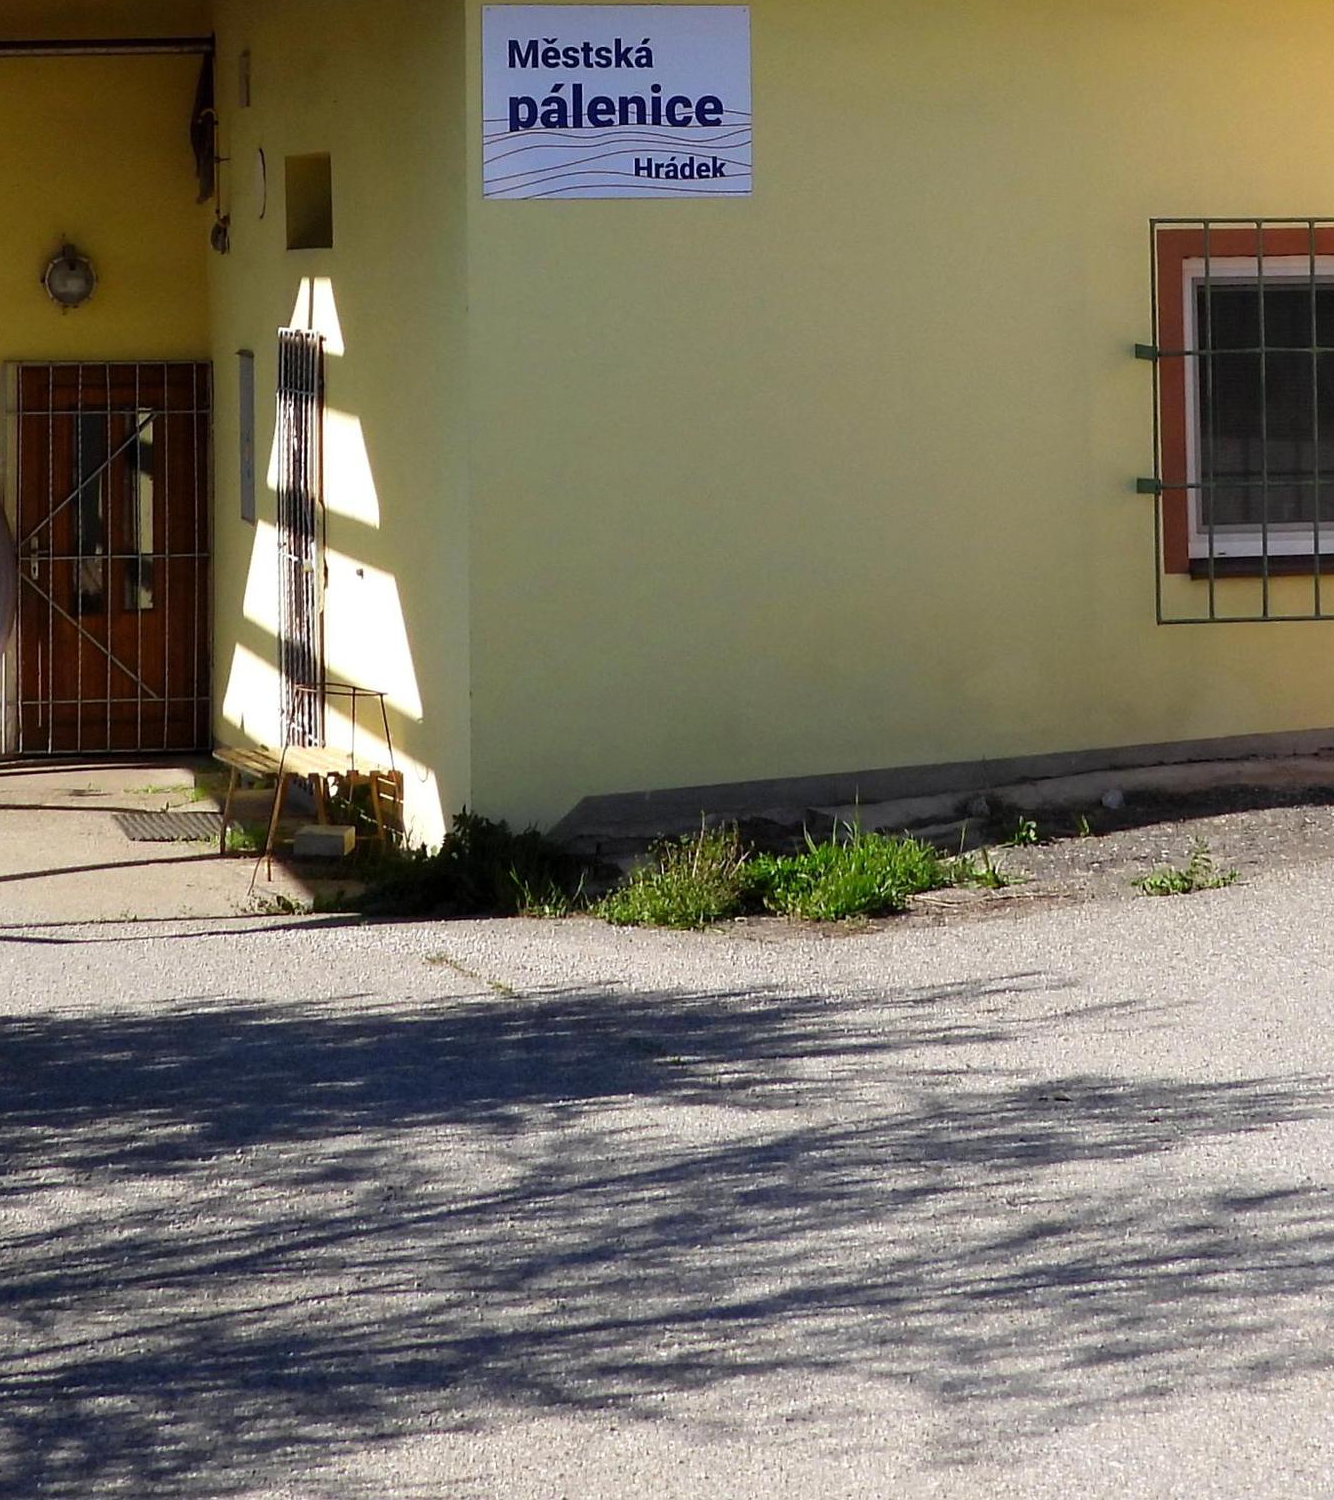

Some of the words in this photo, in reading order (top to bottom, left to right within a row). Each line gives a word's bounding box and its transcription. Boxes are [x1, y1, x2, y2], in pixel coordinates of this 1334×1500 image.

[508, 37, 654, 69] Městská
[509, 83, 724, 132] pálenice
[634, 156, 726, 179] Hrádek
